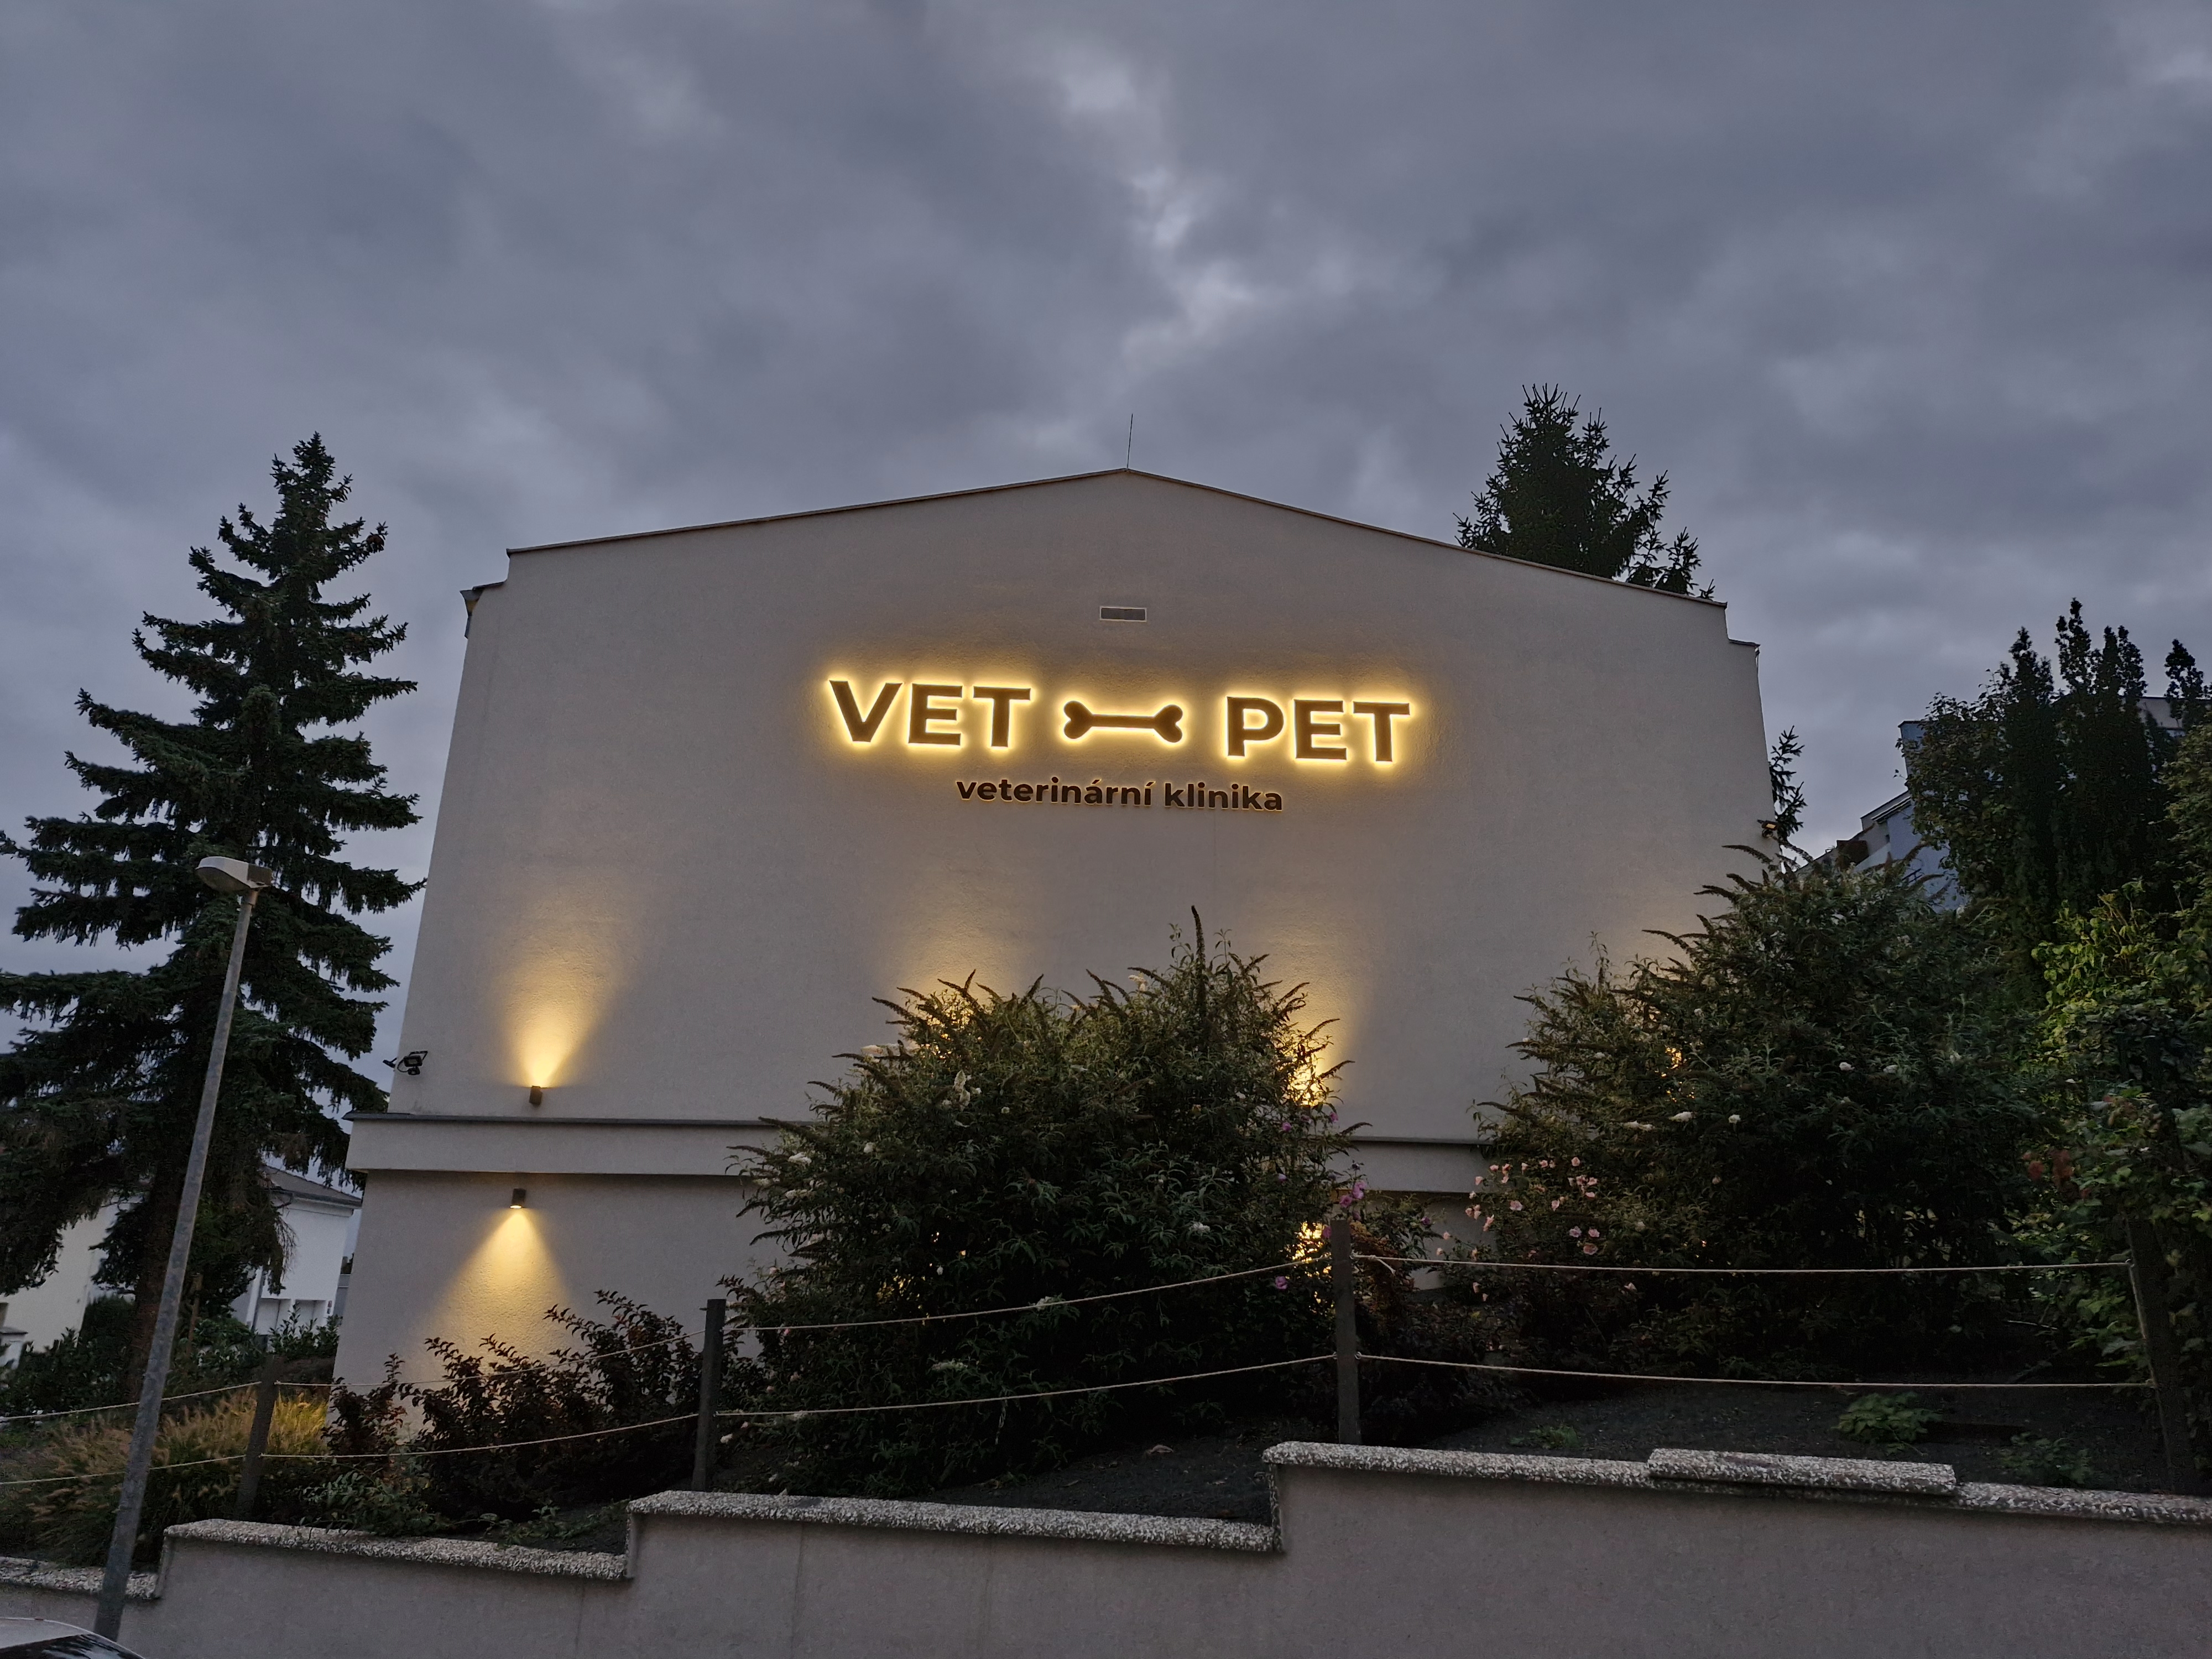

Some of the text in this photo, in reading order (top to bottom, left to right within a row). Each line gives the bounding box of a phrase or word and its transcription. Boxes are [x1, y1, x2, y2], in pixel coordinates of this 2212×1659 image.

[829, 680, 1410, 762] VET PET
[956, 776, 1283, 811] veterinární klinika
